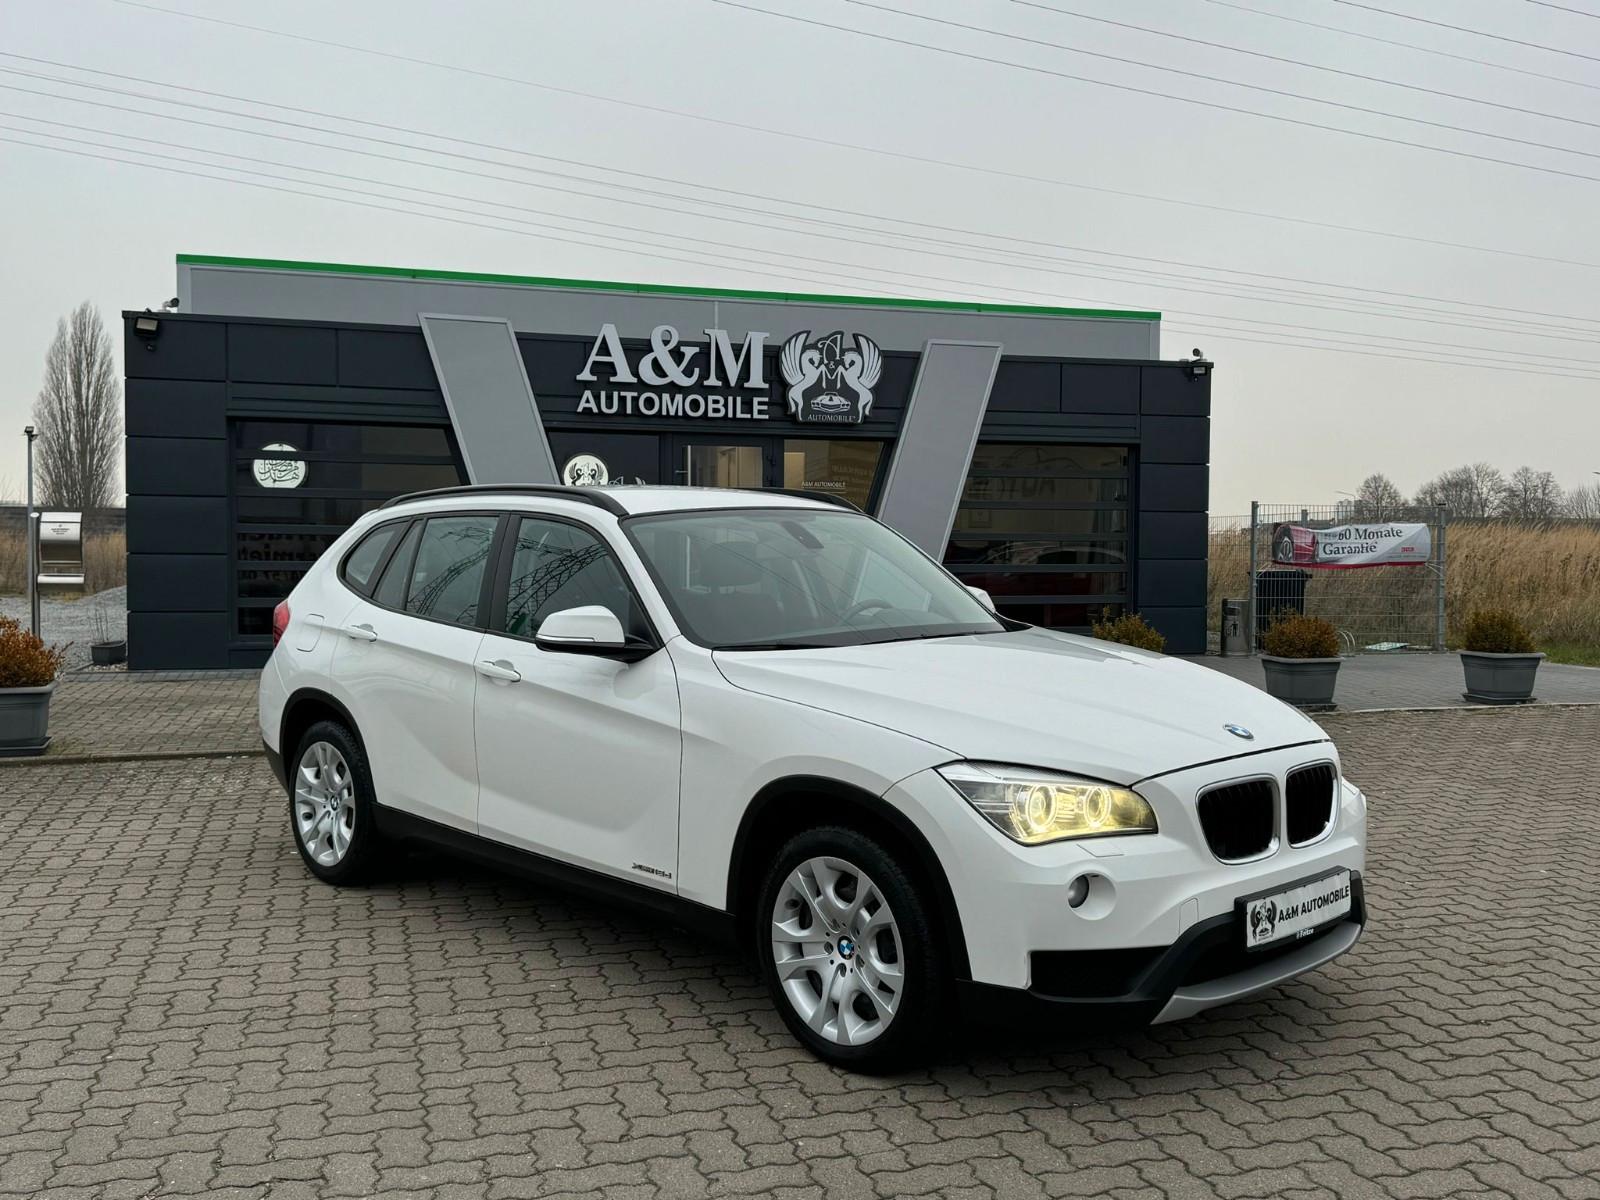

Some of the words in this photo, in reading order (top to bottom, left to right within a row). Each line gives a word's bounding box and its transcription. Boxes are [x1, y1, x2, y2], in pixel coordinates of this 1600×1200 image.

[575, 323, 770, 389] A&M
[576, 389, 770, 420] AUTOMOBILE
[1354, 527, 1403, 540] Monate
[1278, 904, 1299, 923] A&M
[1300, 885, 1350, 916] AUTOMOBILE
